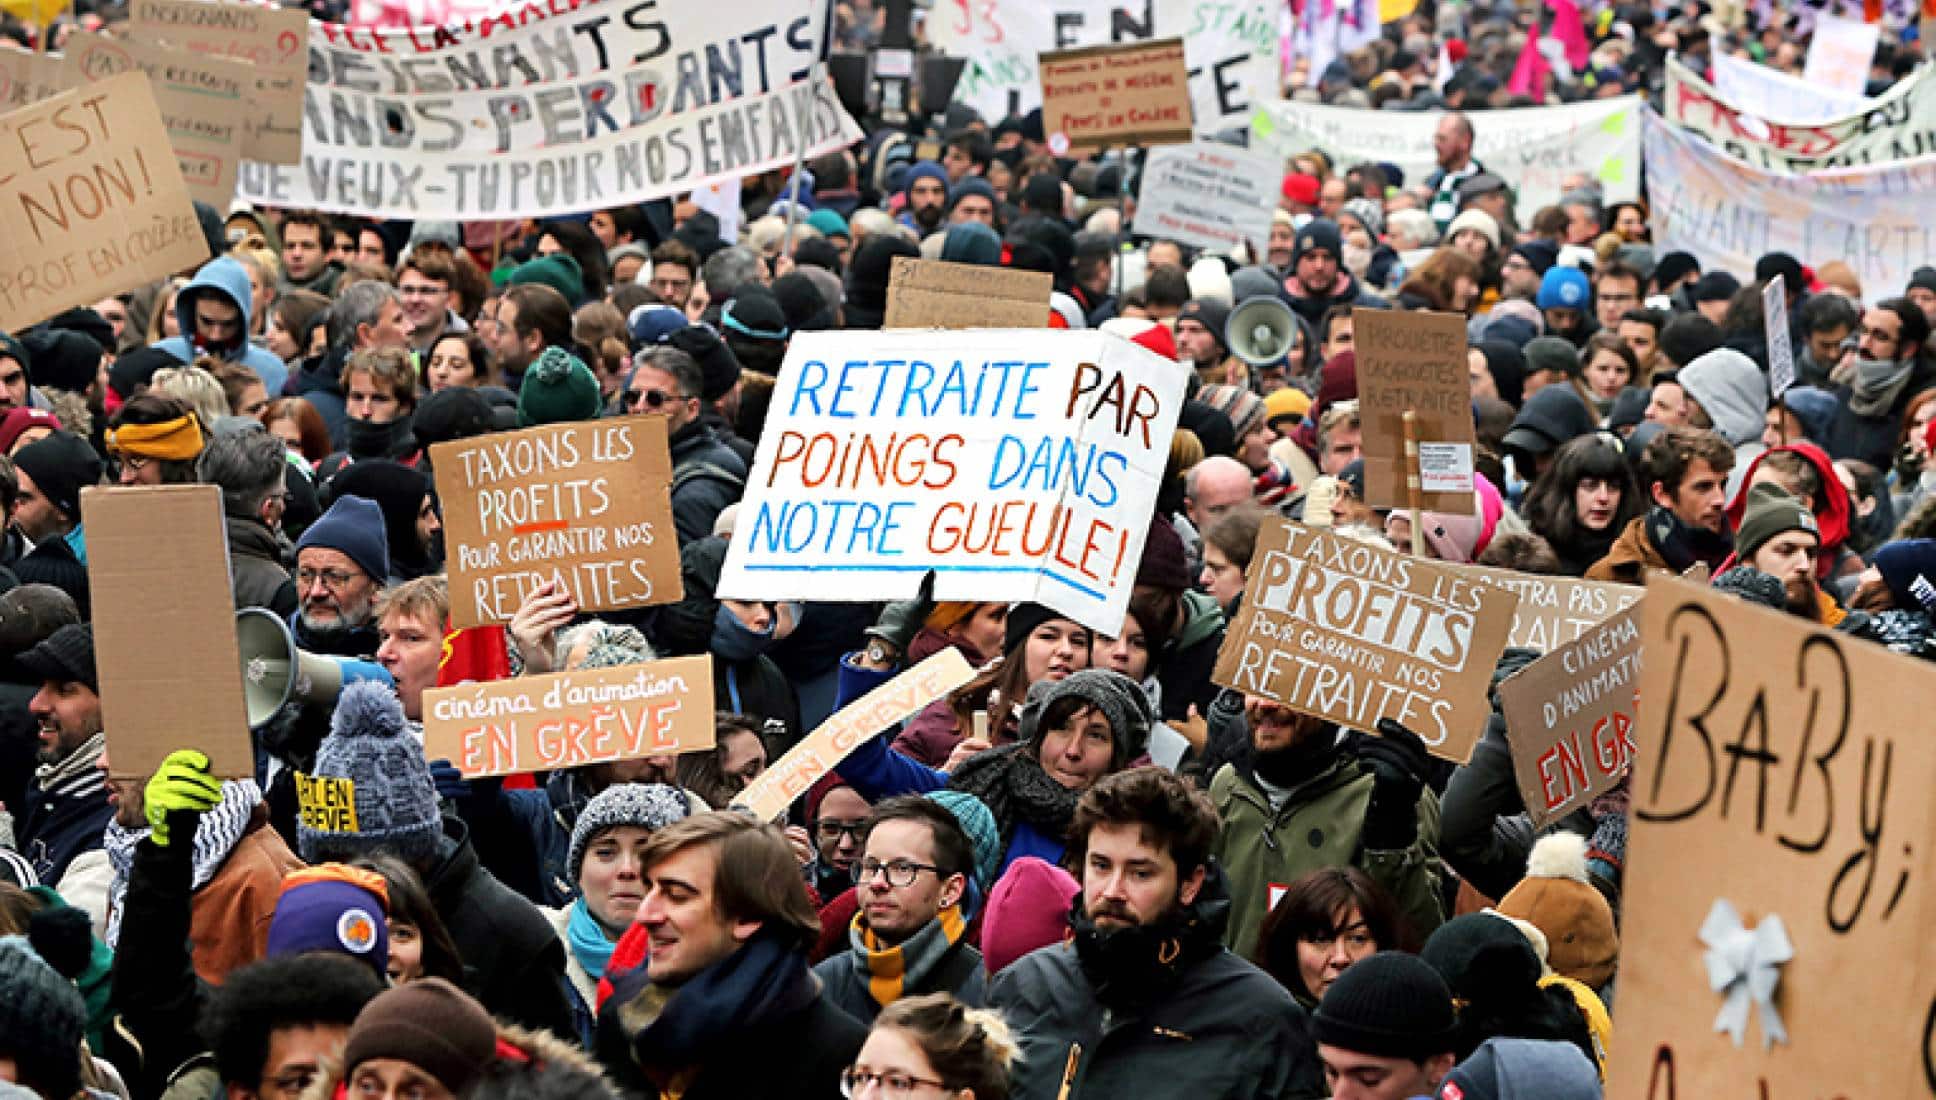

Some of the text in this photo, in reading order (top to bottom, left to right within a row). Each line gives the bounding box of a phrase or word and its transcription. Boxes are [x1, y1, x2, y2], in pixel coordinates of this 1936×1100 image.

[18, 146, 153, 246] NON!
[614, 126, 693, 193] NOS
[86, 239, 123, 277] EN
[1064, 361, 1160, 450] PAR
[456, 426, 635, 488] TAXONS LES
[988, 434, 1128, 508] DANS
[476, 477, 610, 537] PROFITS
[748, 500, 1130, 588] NOTRE GUEULE!
[457, 521, 655, 574] POUR GARANTIR NOS
[1280, 523, 1486, 613] TAXONS LES
[1255, 551, 1475, 673] PROFITS
[1568, 584, 1609, 615] PAS
[1249, 609, 1442, 693] POUR GARANTIR NOS
[432, 669, 690, 721] cinéma d'animation
[1231, 640, 1454, 747] RETRAITES
[460, 699, 683, 776] EN GRÈVE
[1535, 730, 1590, 813] EN
[779, 756, 824, 800] EN
